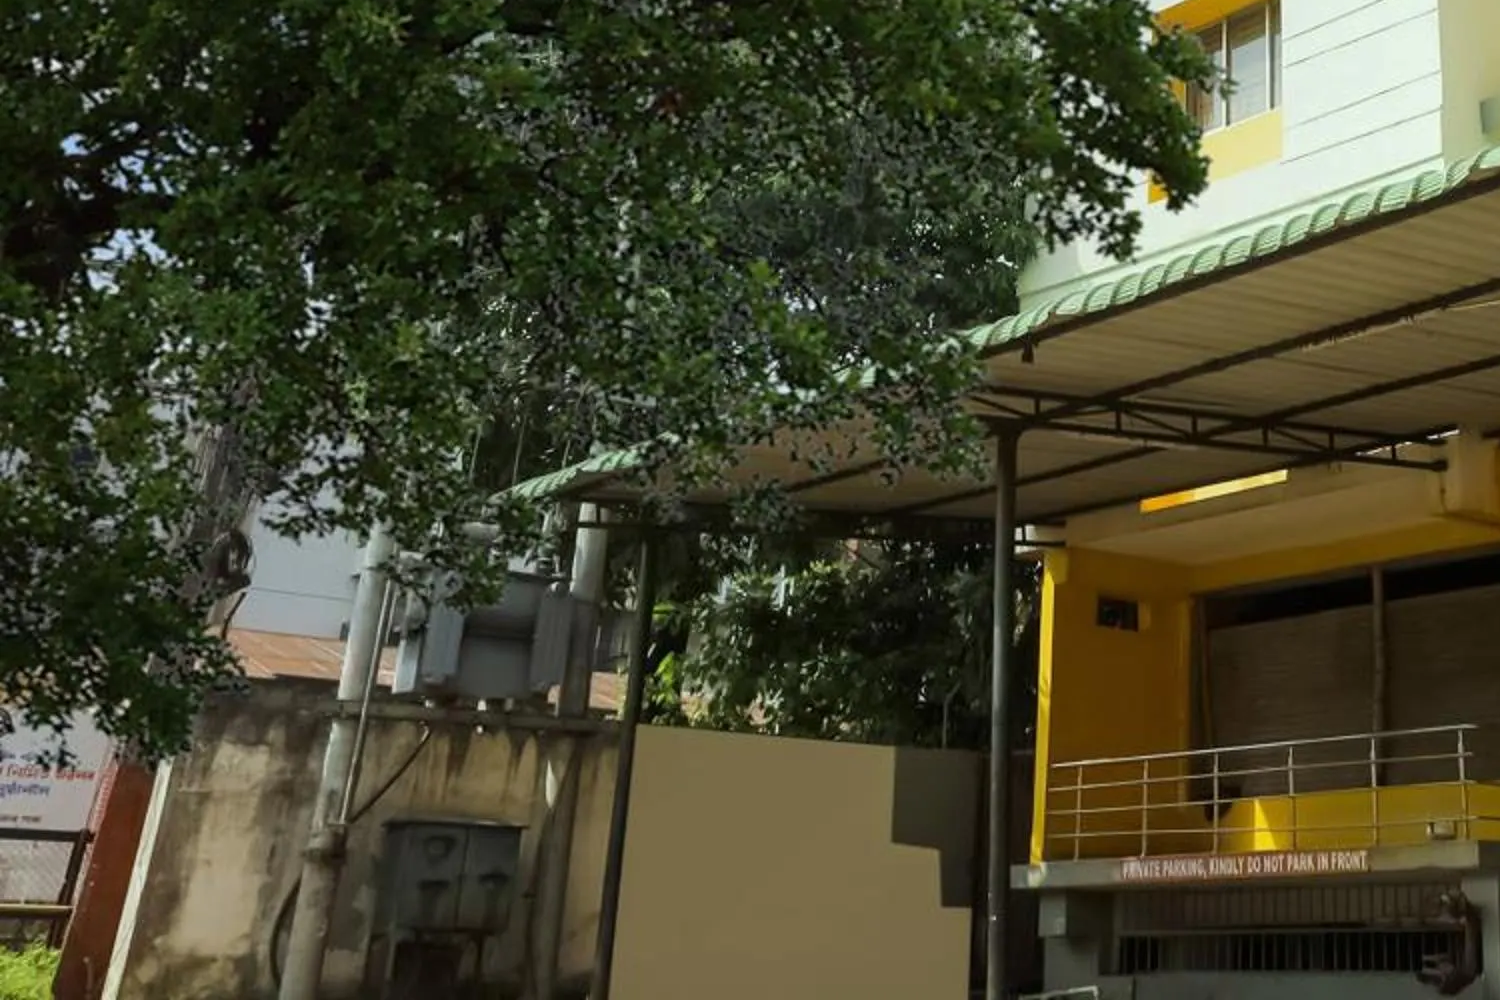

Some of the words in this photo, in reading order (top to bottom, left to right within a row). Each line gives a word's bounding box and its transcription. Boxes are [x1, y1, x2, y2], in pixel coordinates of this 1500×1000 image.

[1247, 856, 1261, 873] DO
[1263, 854, 1283, 873] NOT
[1287, 852, 1316, 872] PARK
[1317, 851, 1329, 871] IN
